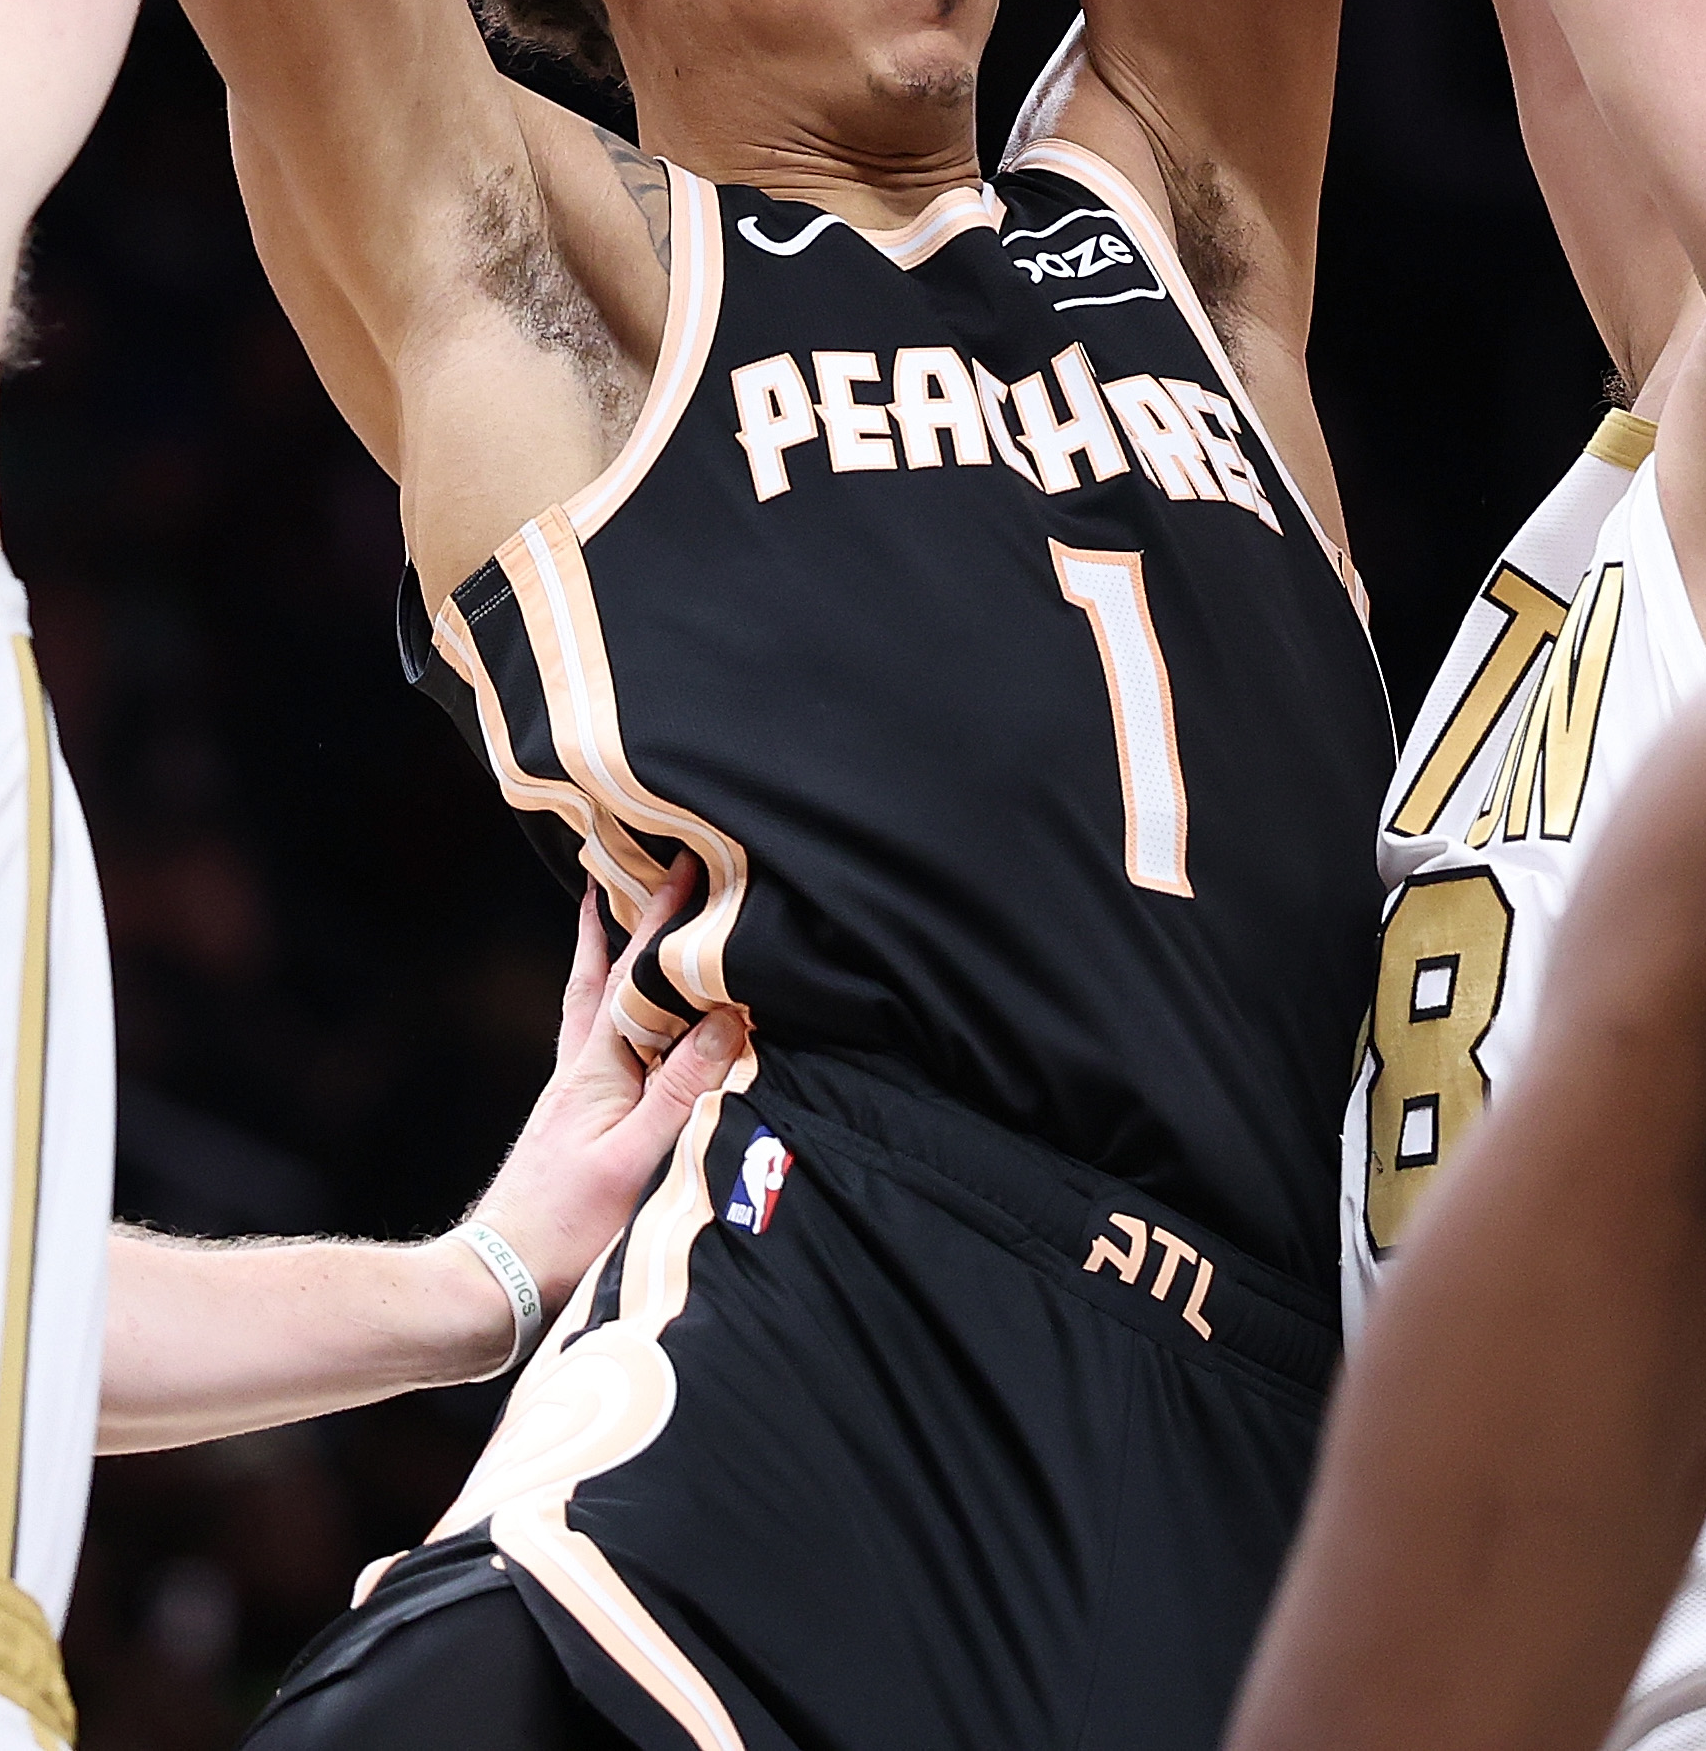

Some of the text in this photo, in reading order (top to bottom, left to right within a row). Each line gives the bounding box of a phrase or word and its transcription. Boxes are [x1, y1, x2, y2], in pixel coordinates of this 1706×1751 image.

[1047, 536, 1195, 899] 1
[487, 1241, 537, 1318] CELTICS
[1082, 1211, 1215, 1341] ATL
